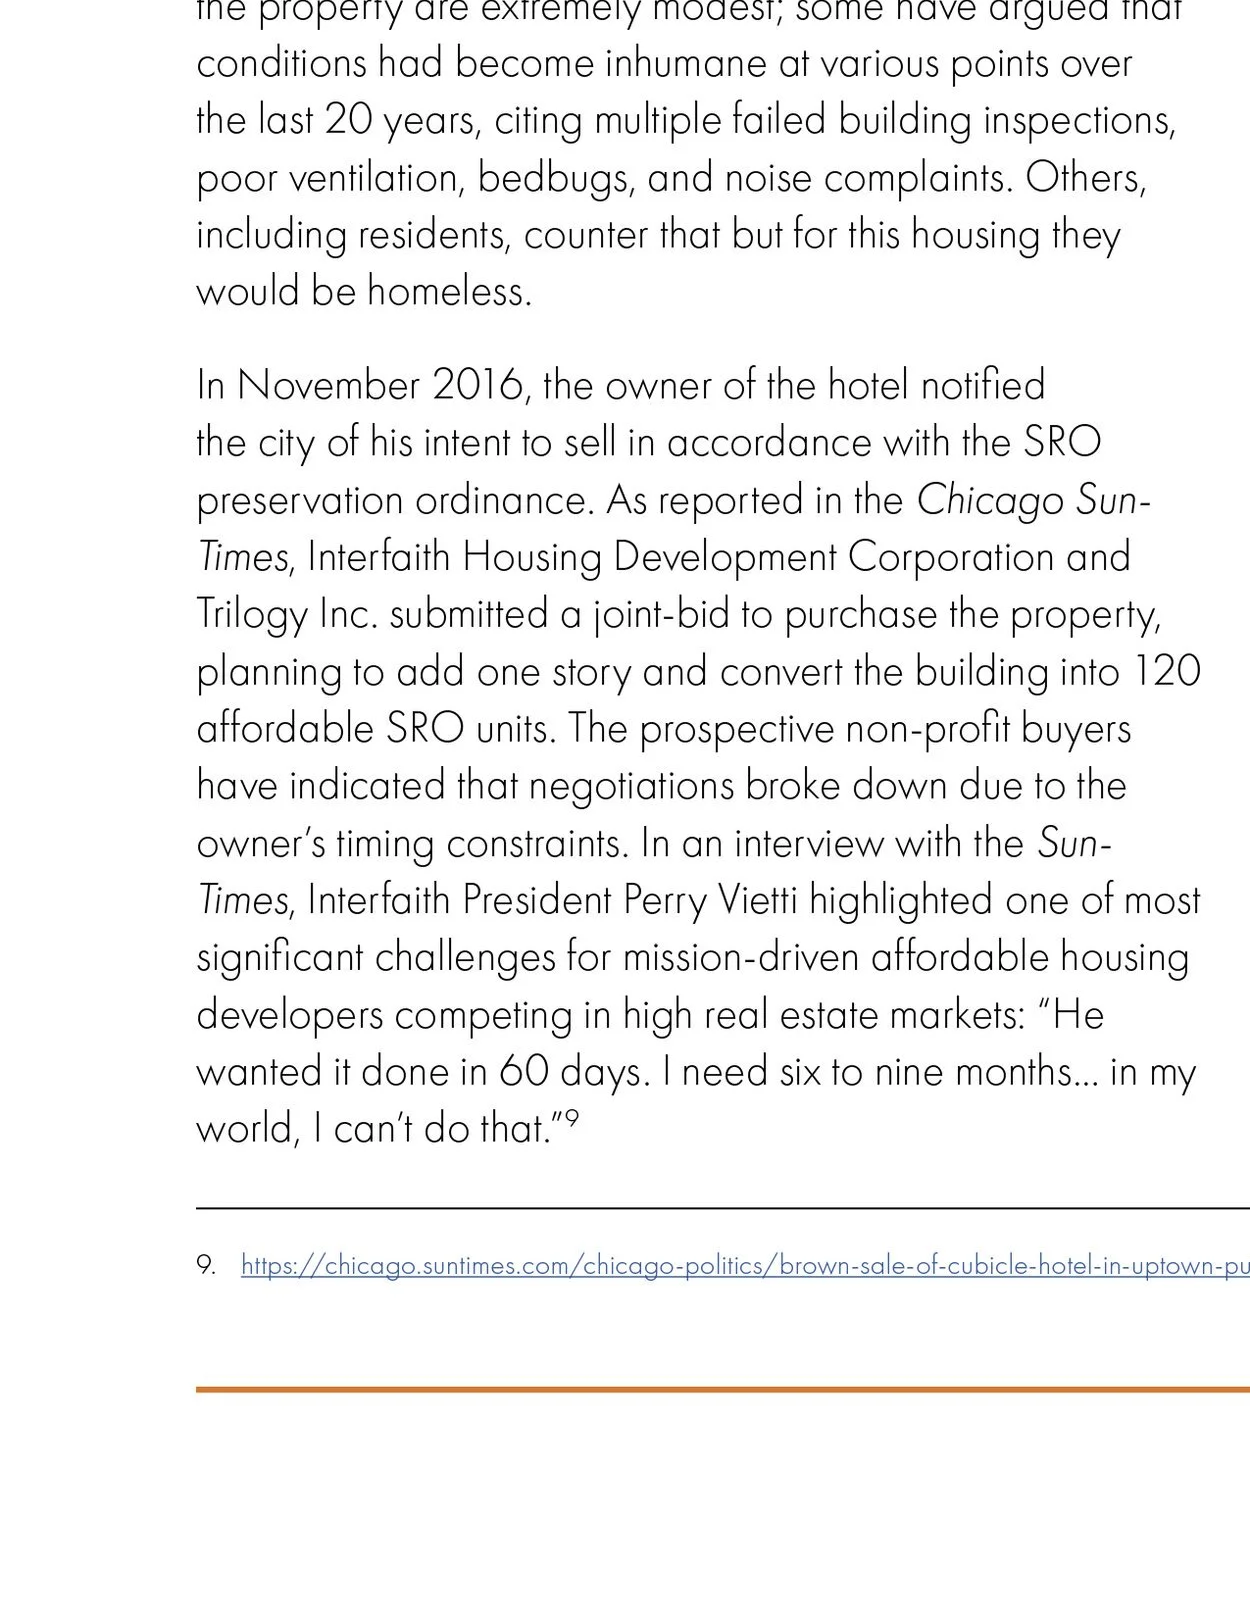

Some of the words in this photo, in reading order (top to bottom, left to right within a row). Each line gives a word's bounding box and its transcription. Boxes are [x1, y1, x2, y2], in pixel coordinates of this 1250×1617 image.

[196, 272, 297, 306] would
[314, 272, 355, 305] be
[369, 272, 531, 306] homeless.
[200, 368, 223, 399] In
[240, 366, 420, 400] November
[434, 367, 530, 405] 2016,
[544, 366, 592, 400] the
[607, 379, 712, 400] owner
[724, 365, 756, 400] of
[768, 366, 815, 400] the
[830, 366, 906, 400] hotel
[923, 365, 1044, 400] notified
[197, 1254, 215, 1274] 9.
